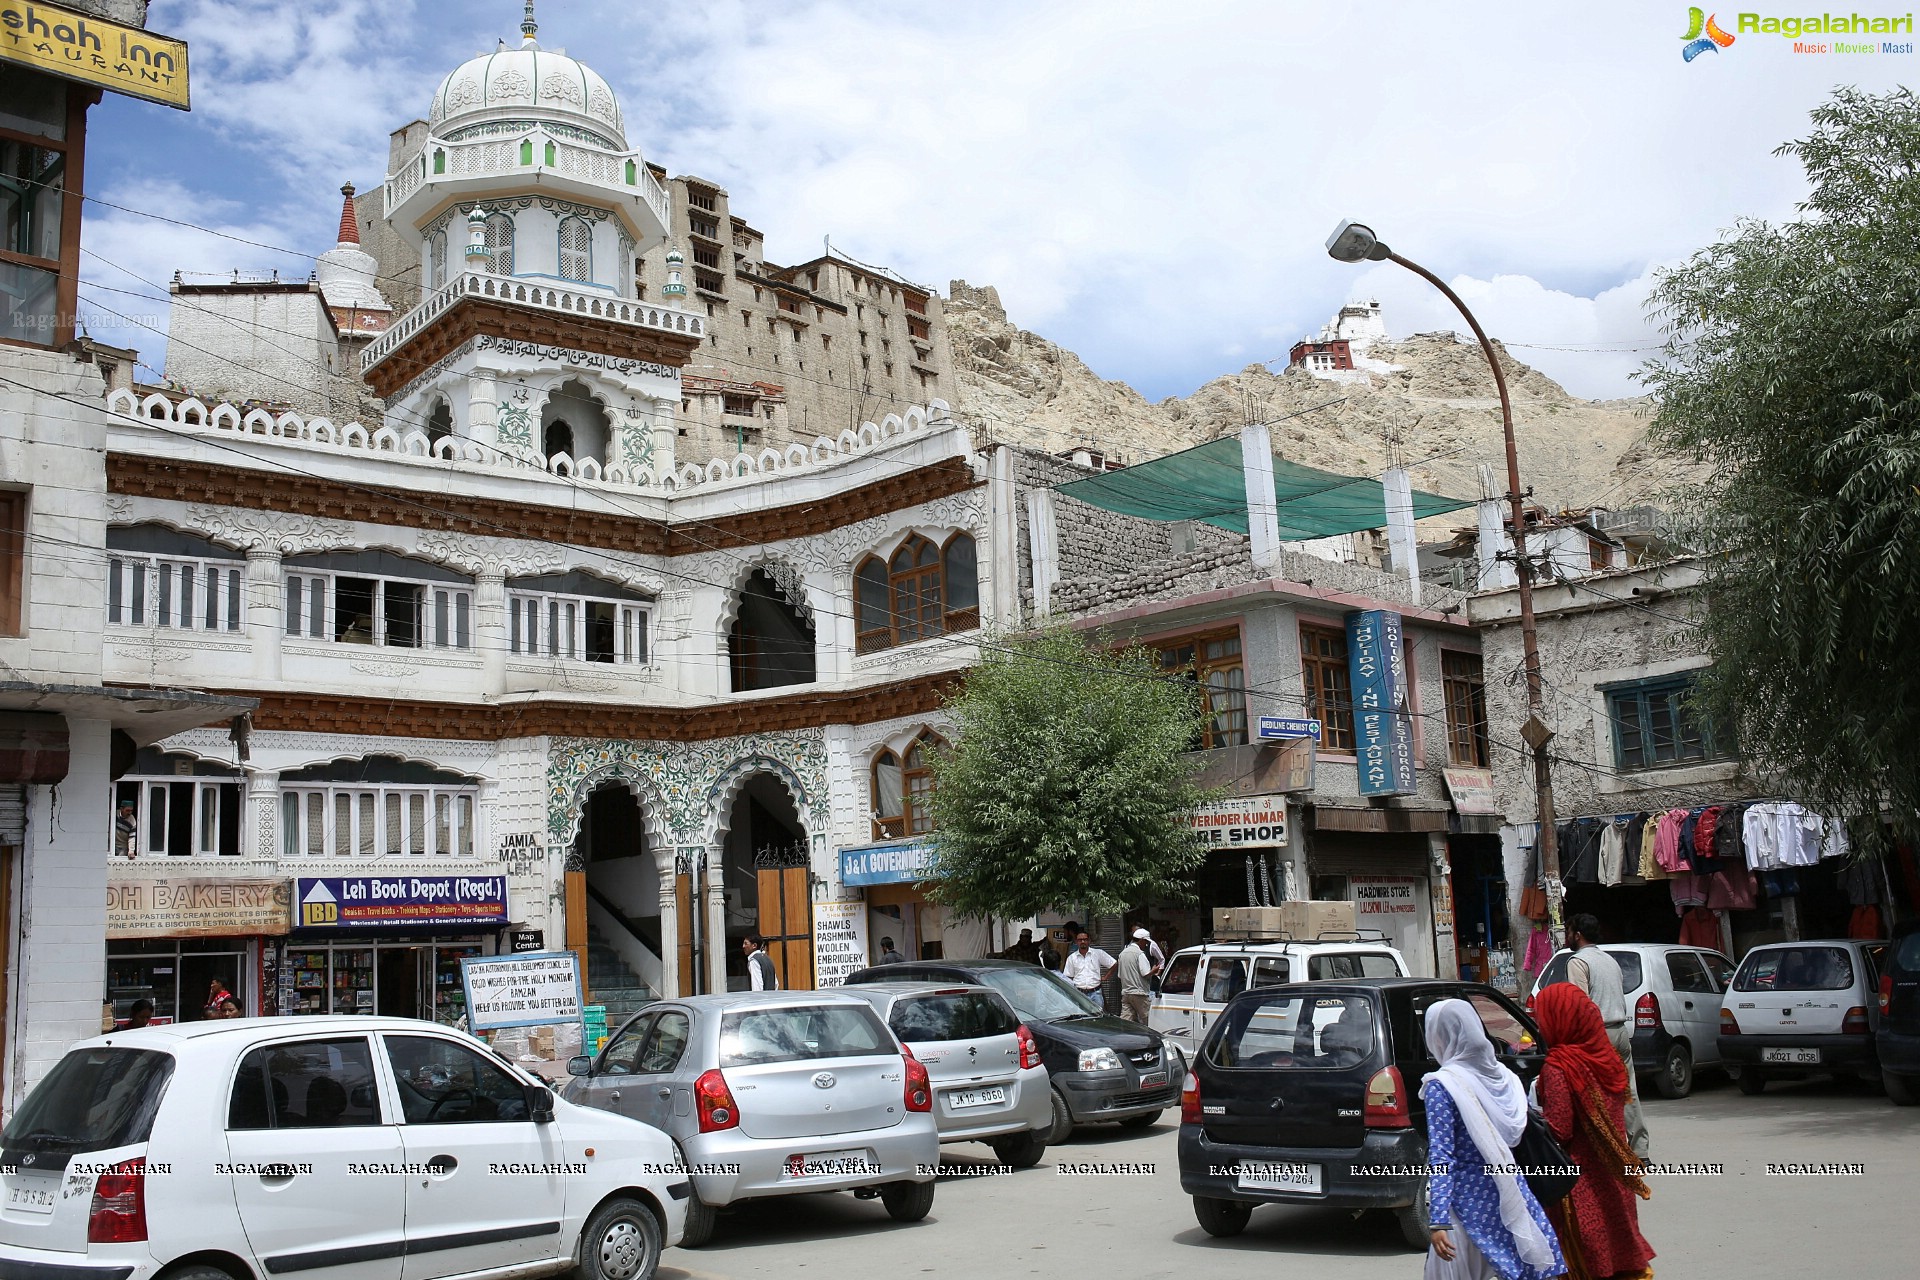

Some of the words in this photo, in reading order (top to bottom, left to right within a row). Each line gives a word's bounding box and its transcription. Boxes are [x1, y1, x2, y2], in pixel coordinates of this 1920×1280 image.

[120, 32, 175, 72] Inn
[1356, 627, 1376, 678] HOLIDAY
[1362, 688, 1378, 709] INN
[1286, 722, 1308, 731] CHEMIST
[1364, 715, 1385, 788] RESTAURANT
[1191, 813, 1240, 828] VERINDER
[1243, 811, 1284, 825] KUMAR
[1229, 826, 1284, 841] SHOP
[501, 834, 536, 848] JAMIA
[500, 848, 544, 861] MASJID
[507, 862, 532, 875] LEH
[845, 854, 868, 875] J&K
[343, 880, 366, 900] Leh
[372, 880, 407, 900] Book
[411, 878, 450, 901] Depot
[455, 878, 502, 901] (Regd.)
[1358, 886, 1389, 898] HARDWARE
[1391, 886, 1410, 898] STORE
[153, 885, 270, 909] BAKERY
[108, 913, 138, 921] ROLLS,
[140, 912, 181, 920] PASTERYS
[183, 911, 211, 919] CREAM
[213, 910, 253, 918] CHOKLETS
[108, 921, 128, 929] PINE
[165, 920, 200, 928] BISCUITS
[240, 918, 261, 926] GIFTS
[817, 919, 851, 931] SHAWLS
[519, 933, 535, 942] Map
[817, 931, 857, 942] PASHMINA
[515, 941, 540, 950] Centre
[817, 943, 850, 953] WOOLEN
[817, 953, 863, 965] EMBRIODERY
[521, 961, 547, 971] DEVELOPMENT
[818, 965, 839, 976] CHAIN
[531, 974, 546, 984] HOLY
[549, 973, 567, 983] MONTH
[475, 1002, 491, 1013] HELP
[492, 1002, 500, 1012] US
[501, 1001, 526, 1011] PROVIDE
[528, 1000, 540, 1009] YOU
[541, 998, 562, 1009] BETTER
[1767, 1052, 1791, 1061] JK02T
[1797, 1053, 1816, 1062] 0158
[982, 1090, 1003, 1102] 6060
[841, 1157, 865, 1168] 7865
[38, 1190, 54, 1206] 312
